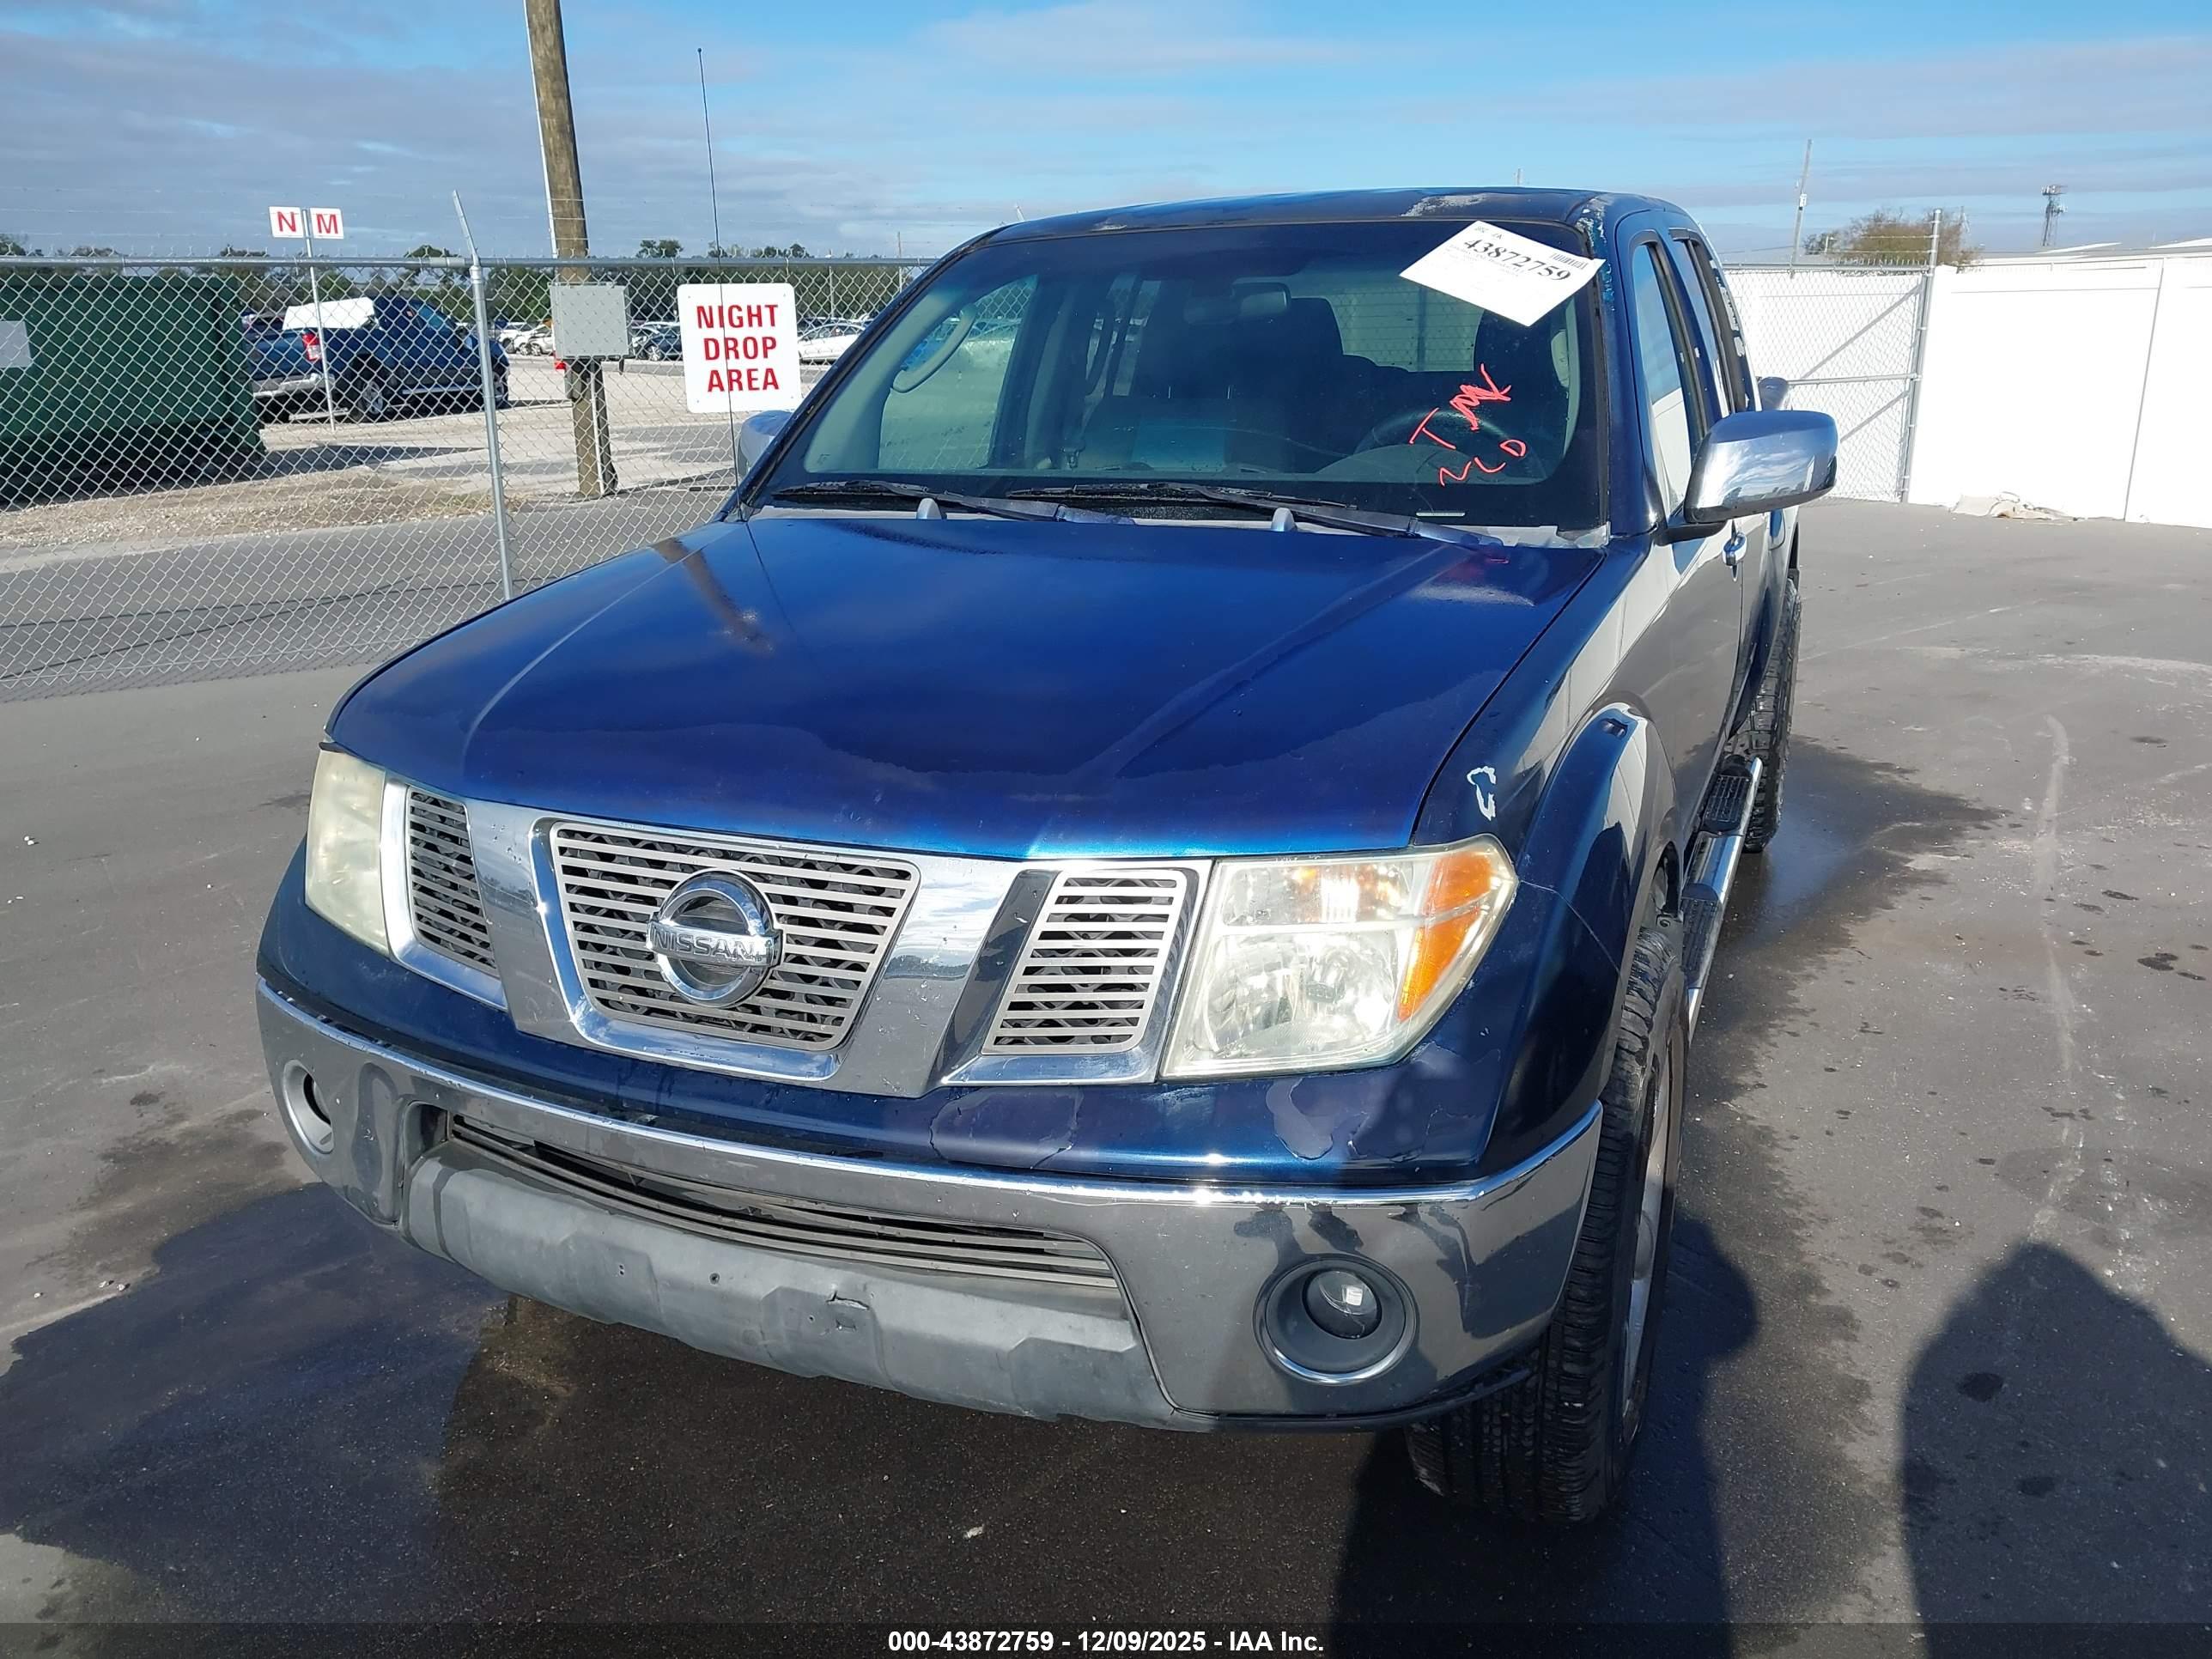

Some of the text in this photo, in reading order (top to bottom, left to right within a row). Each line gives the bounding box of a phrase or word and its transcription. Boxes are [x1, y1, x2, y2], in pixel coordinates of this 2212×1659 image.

[277, 211, 296, 232] N
[316, 214, 338, 234] M
[1464, 239, 1571, 281] 43872759
[696, 304, 778, 328] NIGHT
[703, 337, 777, 361] DROP
[708, 368, 780, 392] AREA
[653, 928, 763, 961] NISSAN
